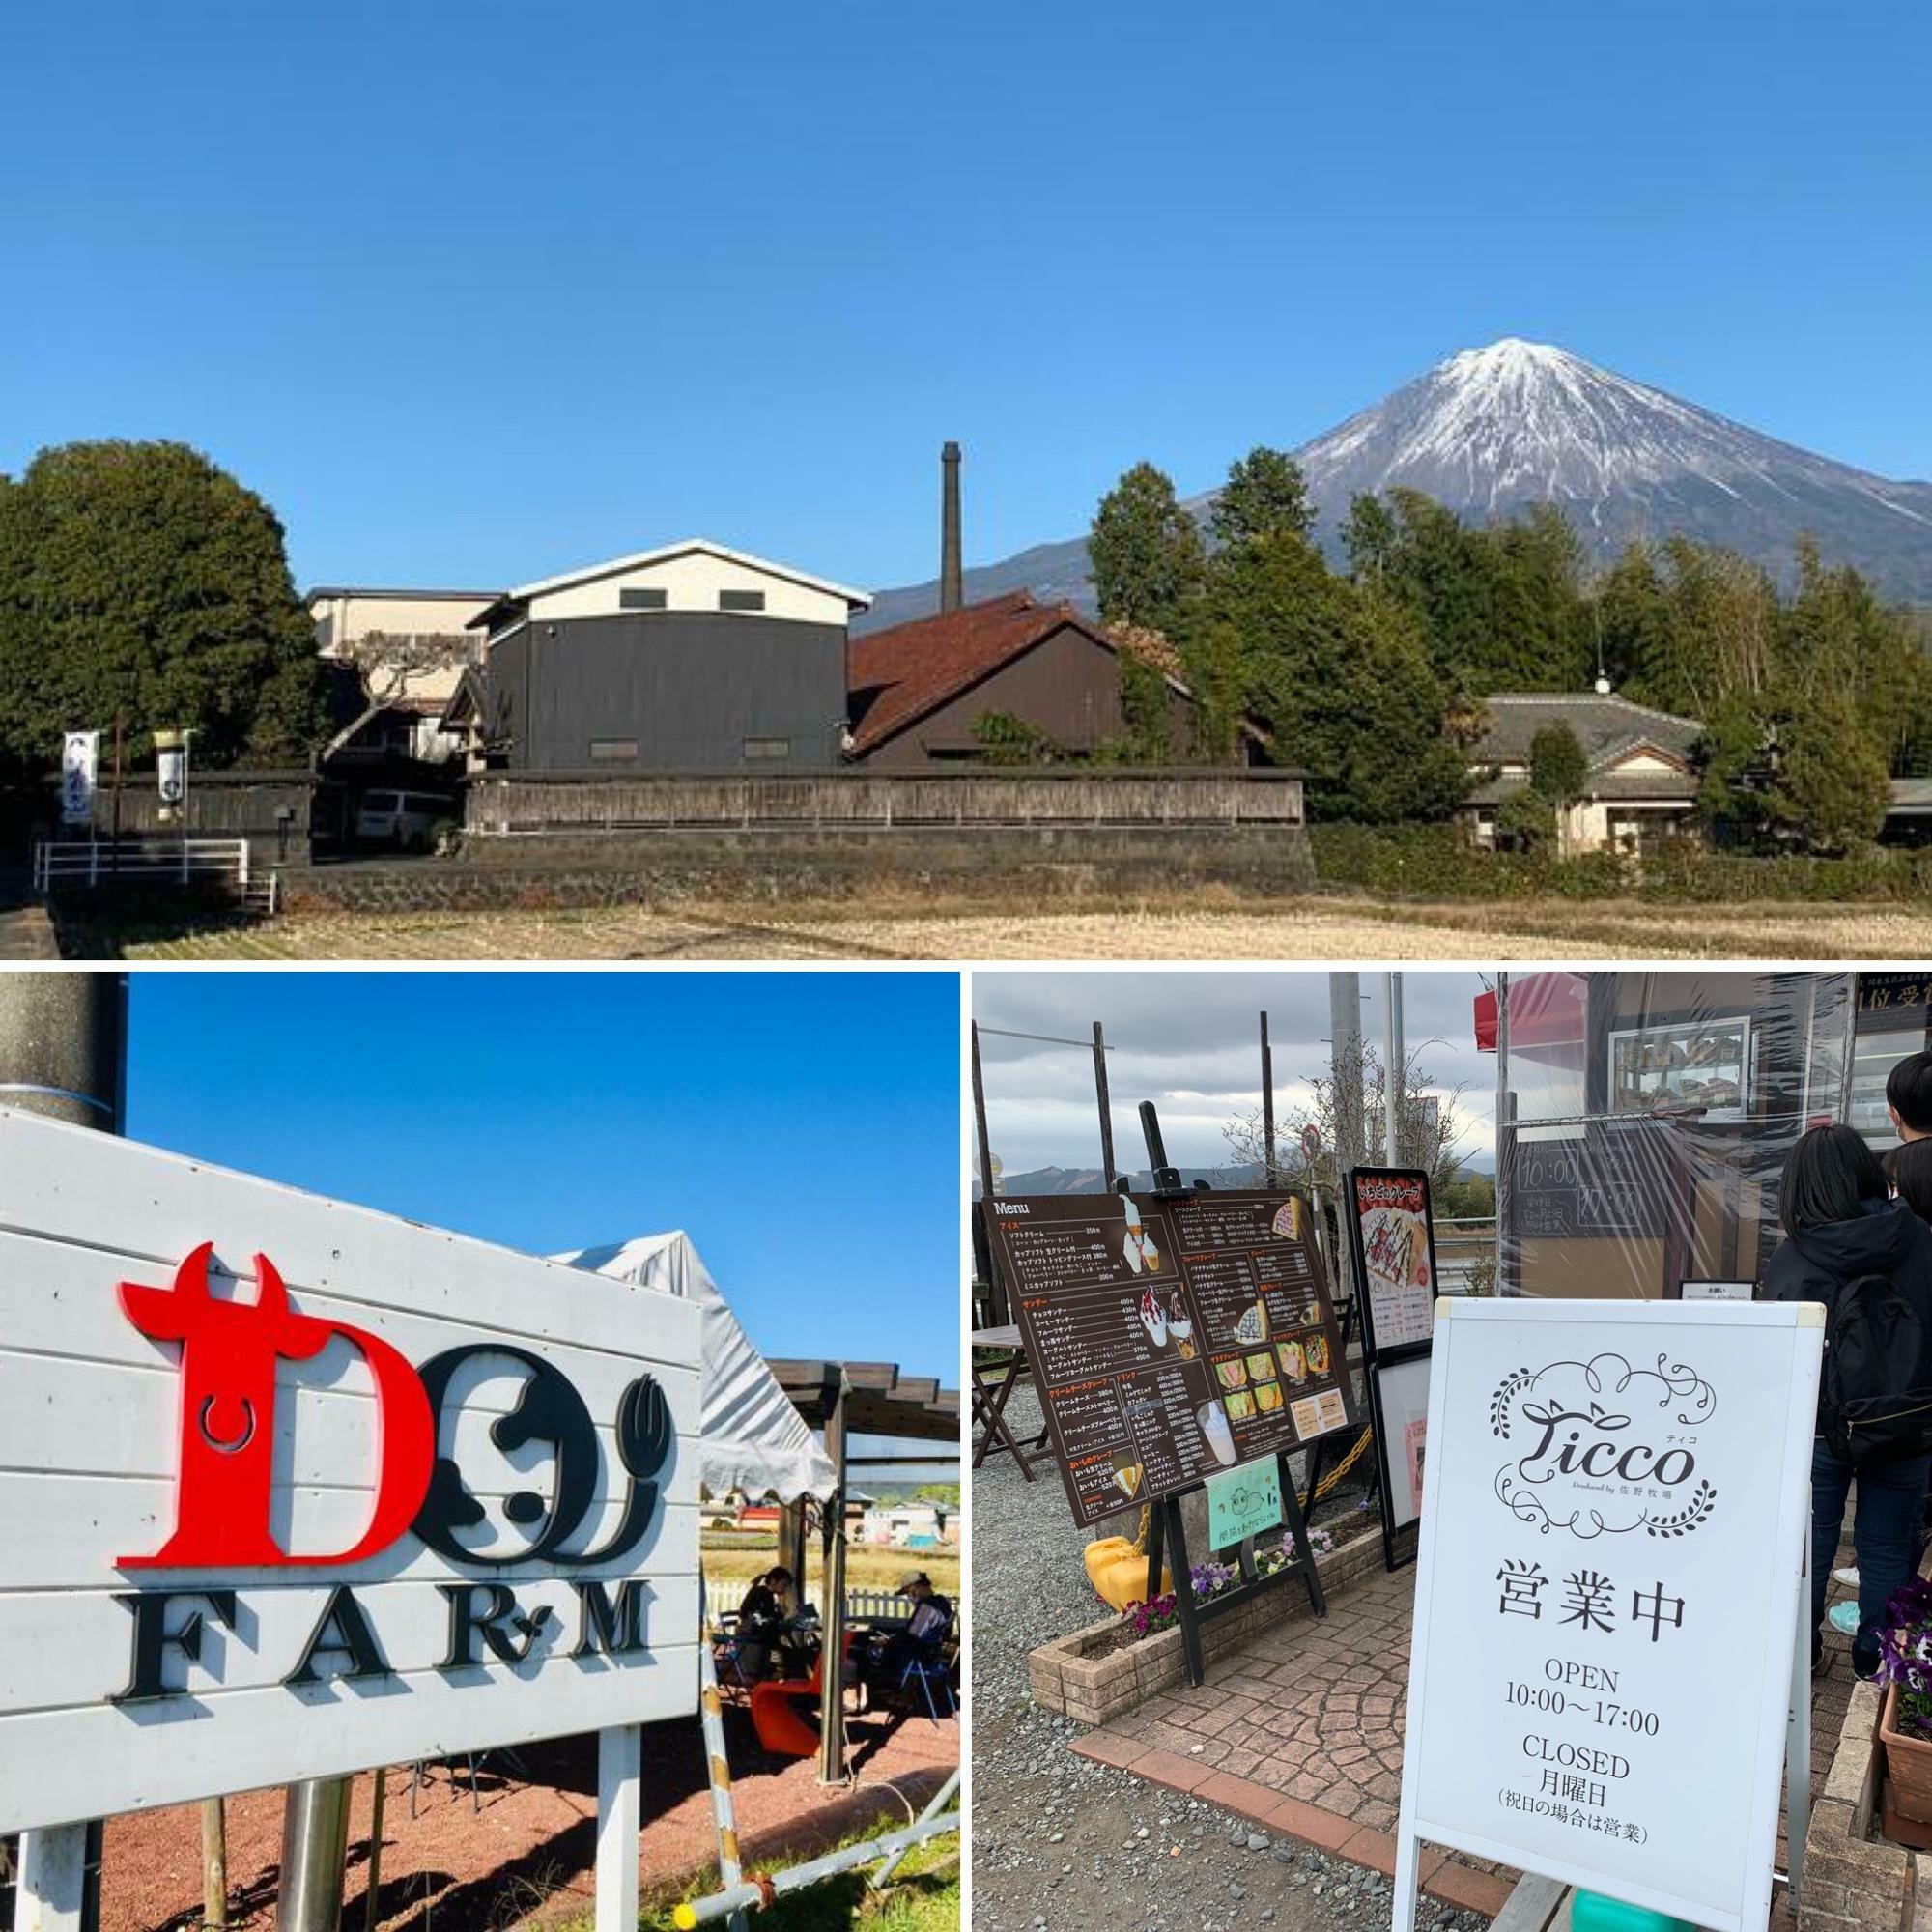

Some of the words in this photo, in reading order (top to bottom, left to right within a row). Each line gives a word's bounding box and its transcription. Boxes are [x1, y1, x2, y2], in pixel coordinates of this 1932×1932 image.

[1521, 1159, 1577, 1188] 10:00
[993, 1202, 1030, 1215] Menu
[999, 1221, 1020, 1231] アイス
[1022, 1297, 1048, 1309] サンデー
[1116, 1372, 1136, 1382] ドリンク
[1519, 1399, 1695, 1486] Ticco
[1666, 1435, 1697, 1444] ティコ
[1069, 1449, 1114, 1469] おいものクレープ
[1572, 1481, 1605, 1492] Produced
[1605, 1486, 1615, 1495] by
[1619, 1485, 1672, 1499] 佐野牧場
[1496, 1558, 1685, 1642] 営業中
[104, 1582, 650, 1703] FARM
[1545, 1658, 1620, 1693] OPEN
[1522, 1734, 1631, 1779] CLOSED
[1539, 1768, 1606, 1808] 月曜日
